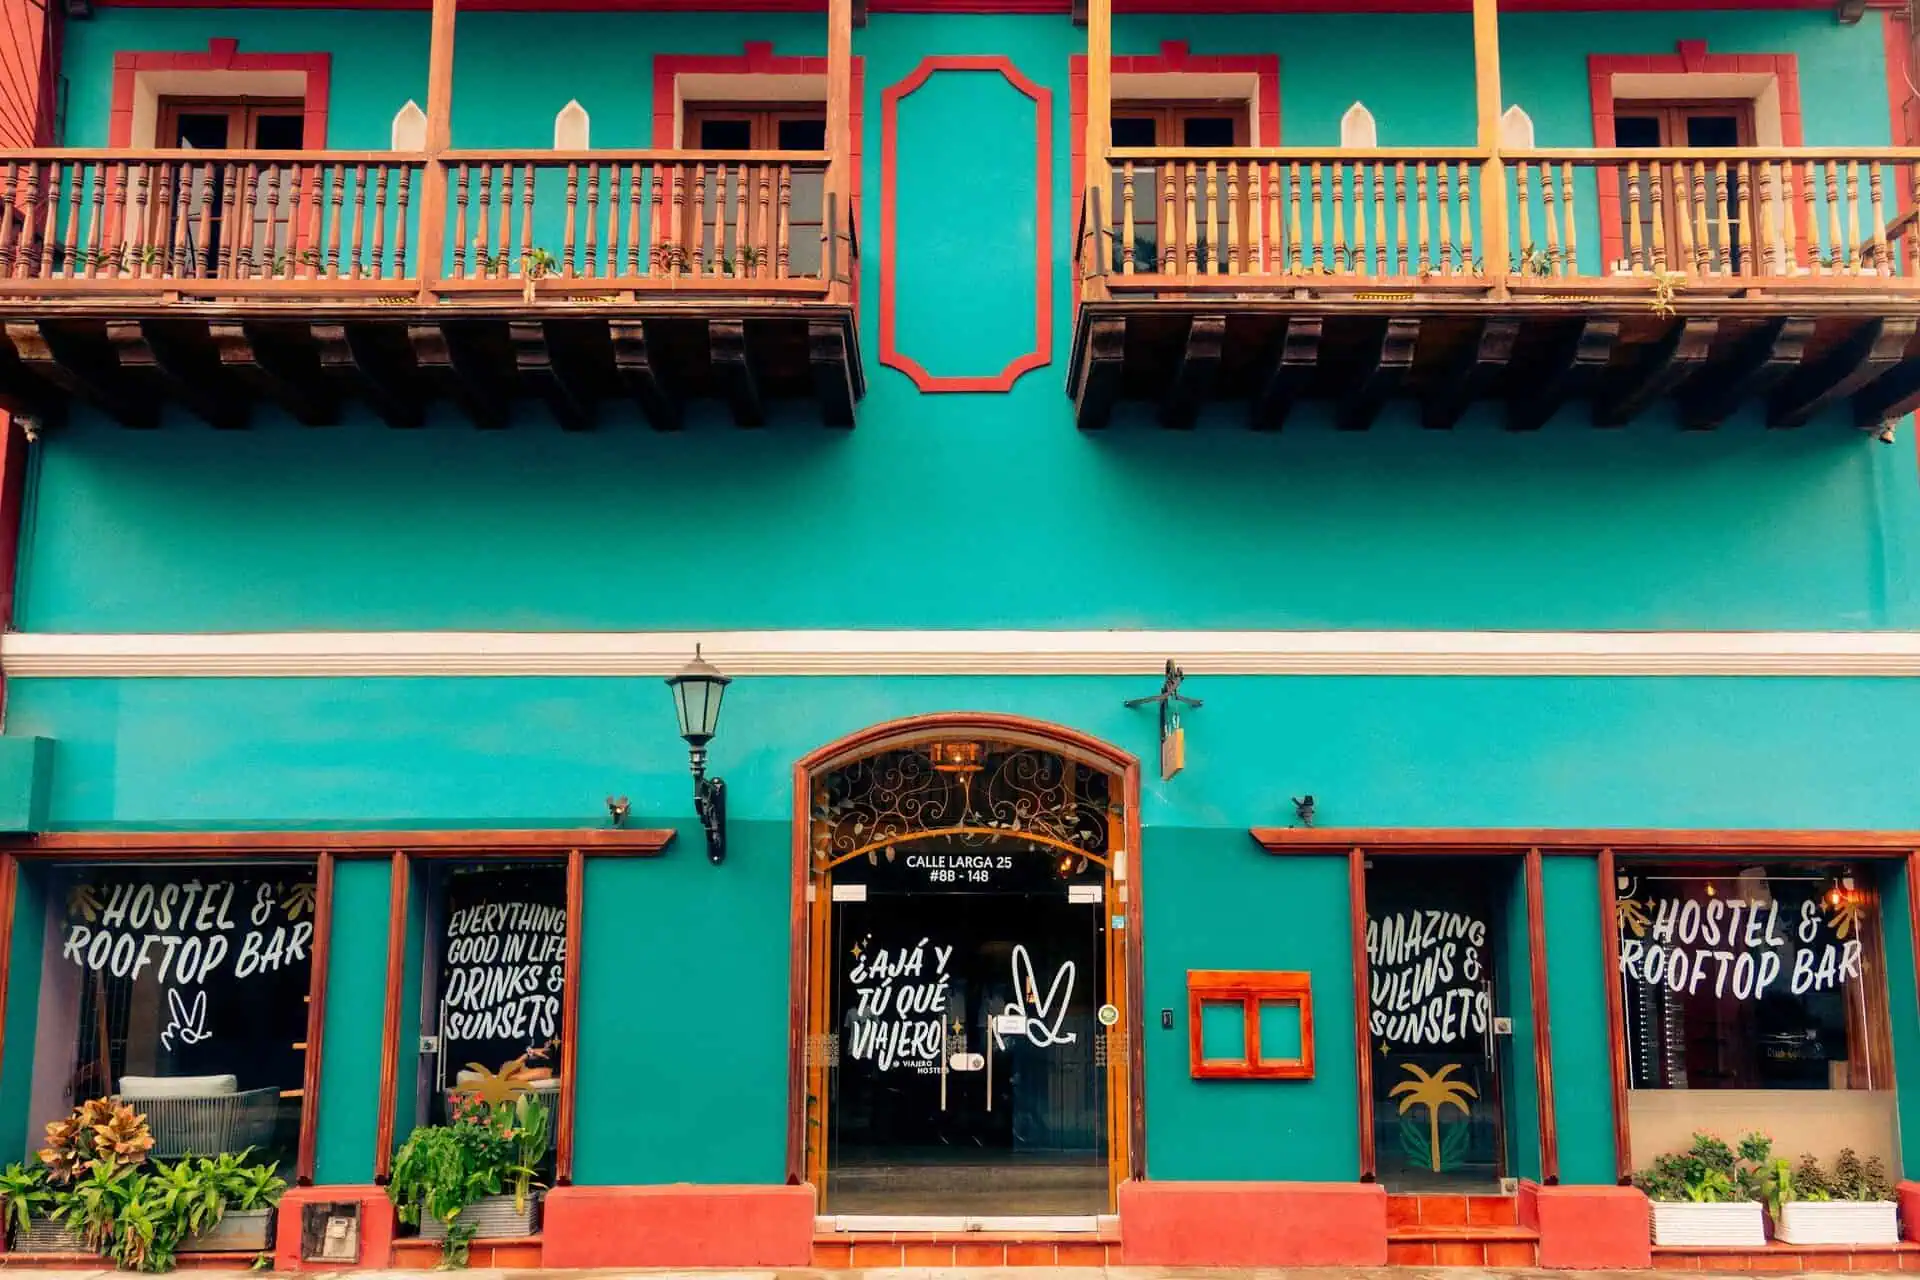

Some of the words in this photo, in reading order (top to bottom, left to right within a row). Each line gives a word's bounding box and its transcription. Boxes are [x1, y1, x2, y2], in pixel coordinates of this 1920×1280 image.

[906, 855, 946, 868] CALLE
[949, 855, 993, 868] LARGA
[996, 856, 1012, 869] 25
[929, 869, 956, 882] #8B
[967, 869, 989, 882] 148
[102, 881, 235, 931] HOSTEL
[252, 882, 276, 926] &
[447, 902, 567, 937] EVERYTHING
[1652, 897, 1785, 947] HOSTEL
[1798, 899, 1822, 943] &
[63, 925, 228, 984] ROOFTOP
[235, 922, 313, 979] BAR
[447, 934, 500, 964] GOOD
[501, 933, 527, 963] IN
[527, 933, 568, 962] LIFE
[849, 937, 929, 984] ¿AJÁ
[934, 945, 953, 974] Y
[1366, 909, 1486, 966] AMAZING
[445, 965, 543, 1011] DRINKS
[546, 965, 565, 992] &
[1371, 942, 1456, 1011] VIEWS
[1463, 946, 1483, 981] &
[1619, 939, 1780, 1000] ROOFTOP
[1791, 939, 1862, 995] BAR
[445, 994, 560, 1040] SUNSETS
[856, 977, 893, 1017] TÚ
[896, 973, 951, 1020] QUÉ
[1369, 988, 1489, 1044] SUNSETS
[851, 1019, 941, 1071] VIAJERO
[902, 1060, 932, 1068] VIAJERO
